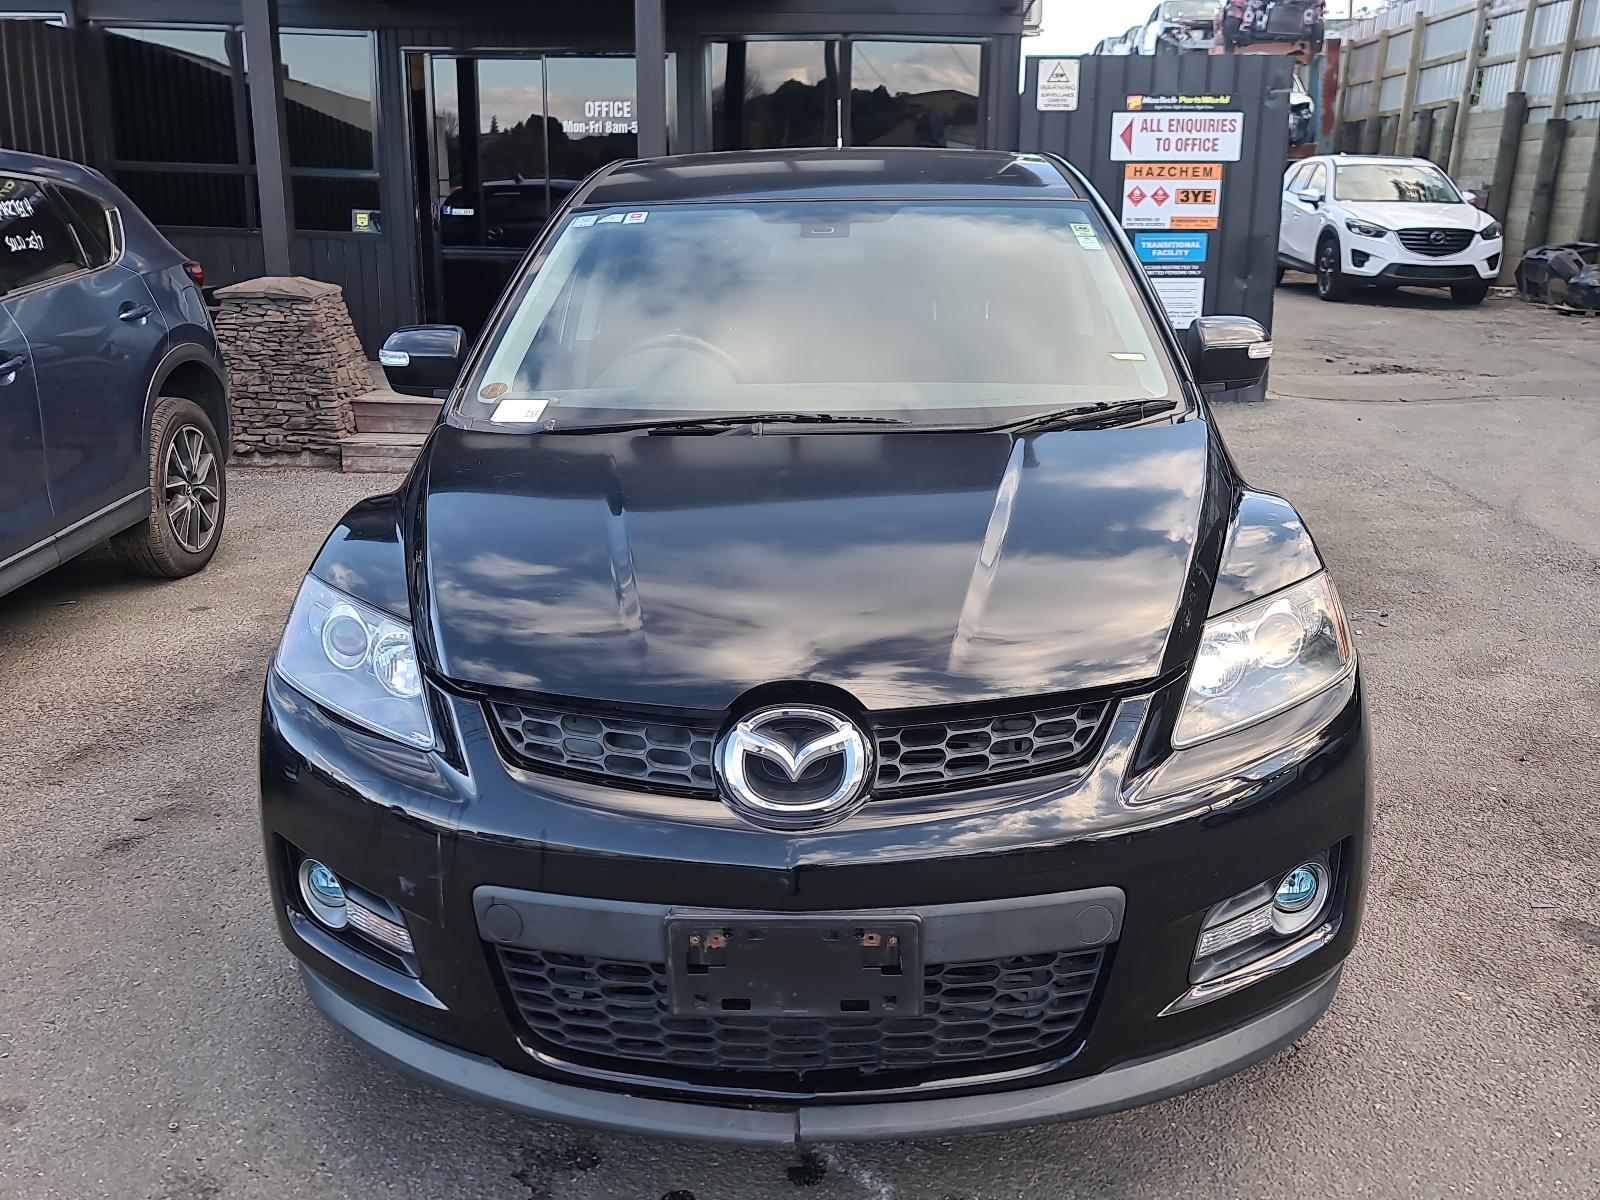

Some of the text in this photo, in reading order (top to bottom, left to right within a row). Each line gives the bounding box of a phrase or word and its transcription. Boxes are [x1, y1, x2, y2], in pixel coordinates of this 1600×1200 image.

[584, 101, 632, 118] OFFICE
[562, 120, 603, 134] Mon-Fri
[1140, 118, 1237, 133] ALL ENQUIRIES
[1155, 138, 1220, 152] TO OFFICE
[1133, 166, 1213, 178] HAZCHEM
[1179, 190, 1212, 203] 3YE
[1141, 241, 1201, 249] TRANSITIONAL
